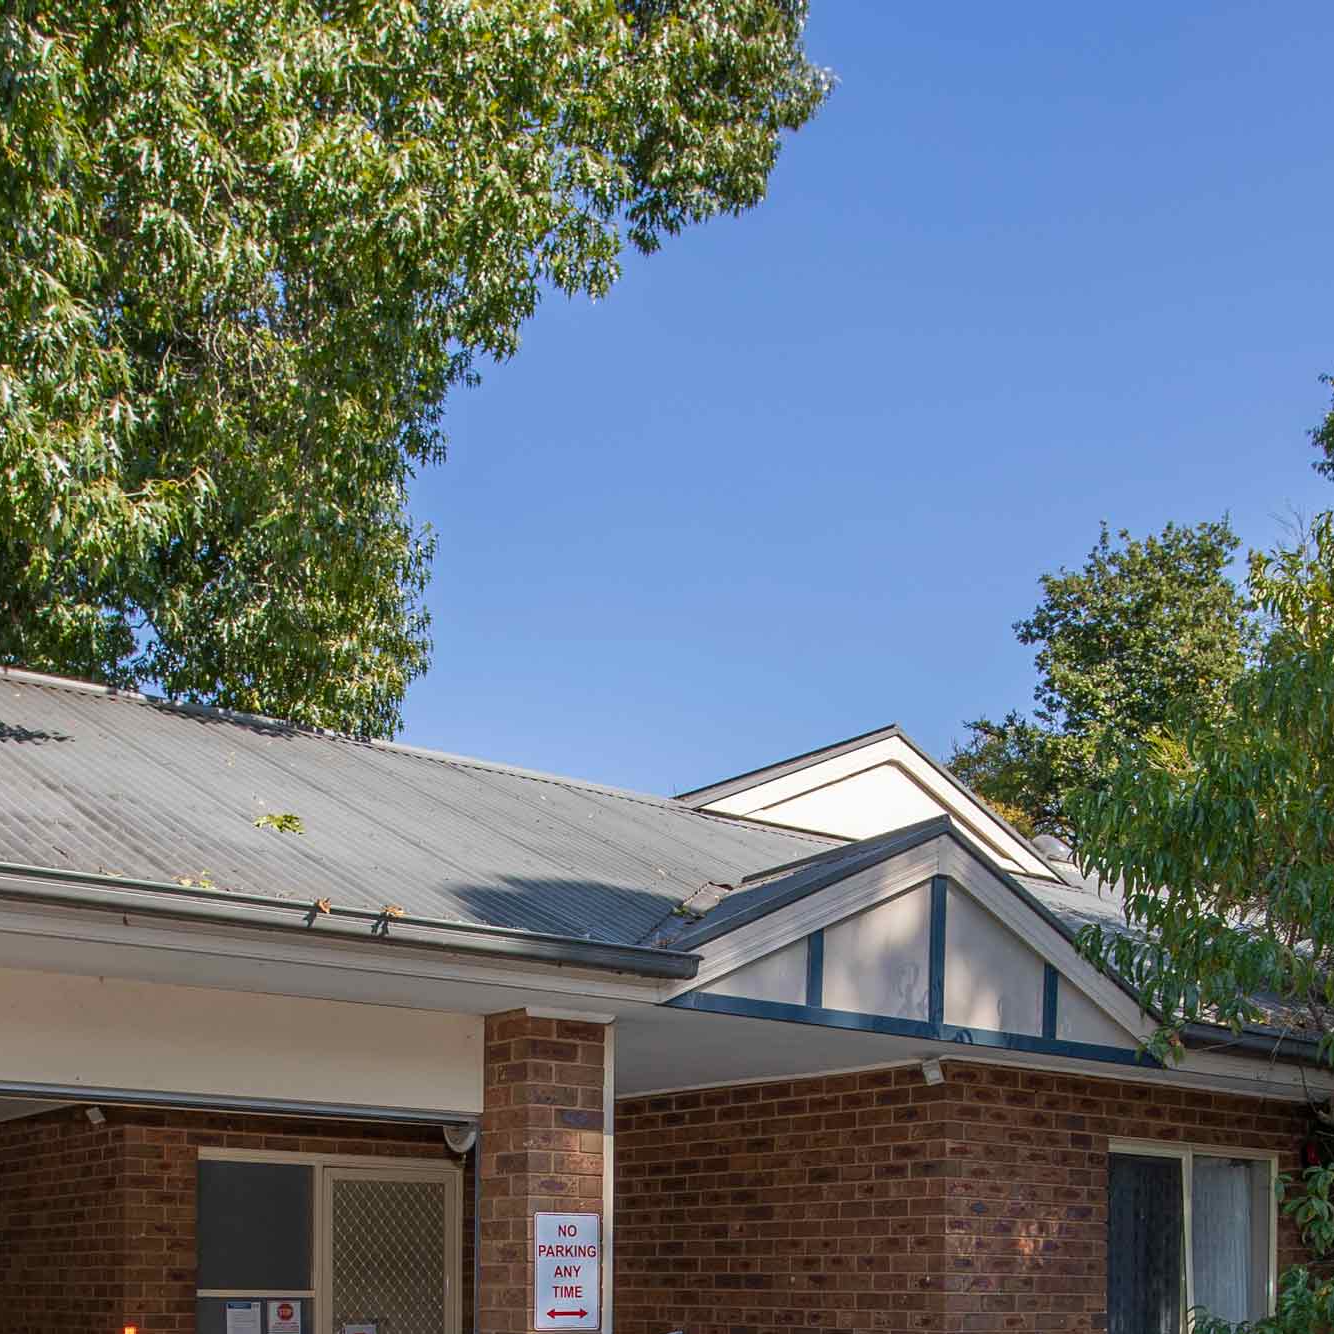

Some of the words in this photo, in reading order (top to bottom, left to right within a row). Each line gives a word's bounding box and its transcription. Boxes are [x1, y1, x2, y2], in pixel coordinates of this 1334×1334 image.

[558, 1225, 577, 1237] NO
[538, 1245, 596, 1258] PARKING
[554, 1265, 581, 1278] ANY
[553, 1286, 583, 1298] TIME
